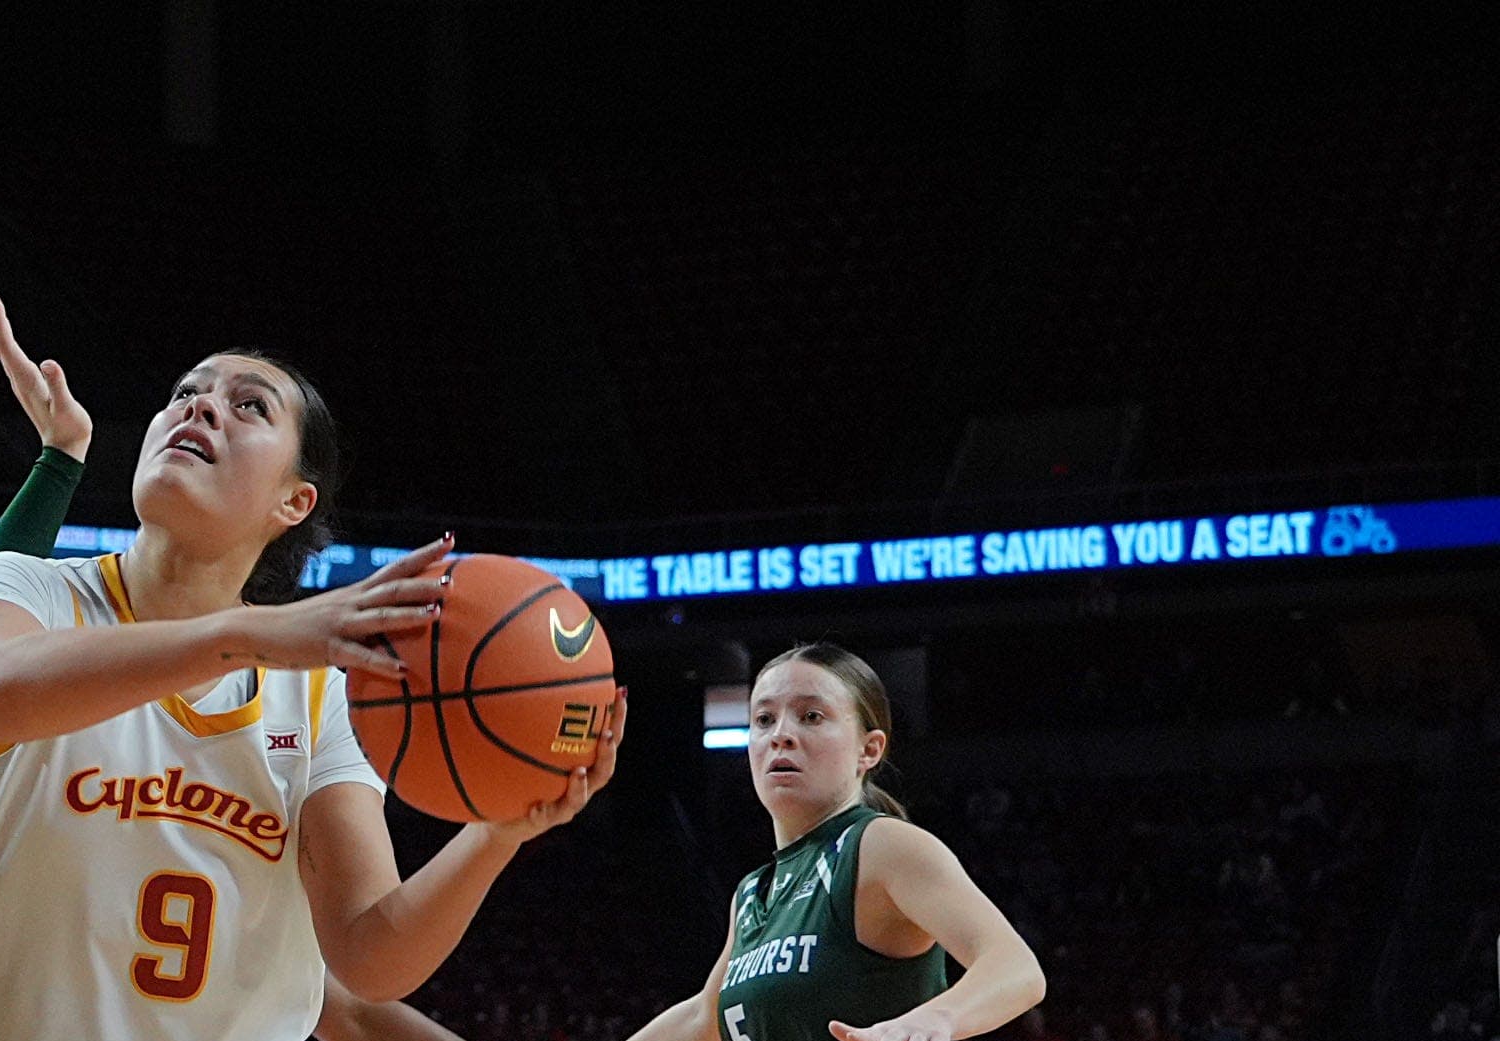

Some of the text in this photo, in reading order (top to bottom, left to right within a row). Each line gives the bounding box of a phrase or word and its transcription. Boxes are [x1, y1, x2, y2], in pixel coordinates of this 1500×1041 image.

[600, 556, 648, 601] HE
[651, 550, 754, 597] TABLE
[758, 546, 794, 590] IS
[799, 542, 861, 587] SET
[871, 535, 976, 582] WE'RE
[981, 526, 1106, 575] SAVING
[1112, 519, 1184, 565] YOU
[1190, 518, 1219, 561] A
[1225, 510, 1315, 558] SEAT
[130, 868, 218, 1003] 9
